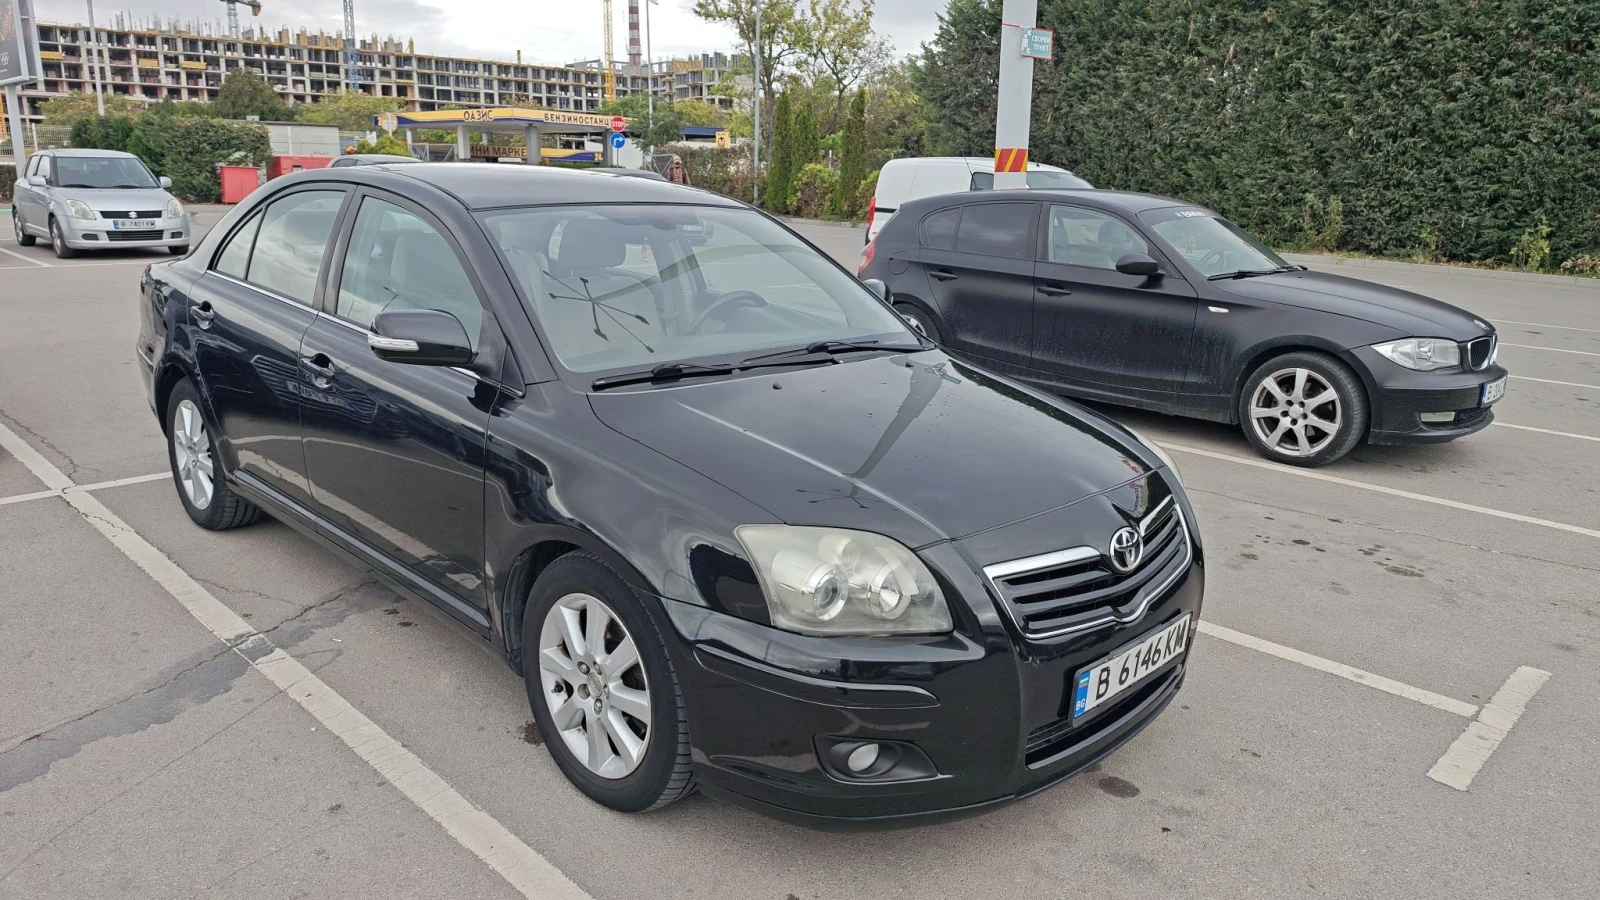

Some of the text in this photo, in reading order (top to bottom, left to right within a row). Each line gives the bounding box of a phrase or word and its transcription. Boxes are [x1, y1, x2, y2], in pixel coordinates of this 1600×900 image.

[463, 110, 493, 120] ОАЗИС
[544, 113, 610, 126] БЕНЗИНОСТАНЦ
[611, 120, 625, 128] STOP
[470, 145, 527, 157] ИНИ МАРКЕ
[1095, 619, 1187, 701] B 6146 KM
[1075, 698, 1086, 712] BG
